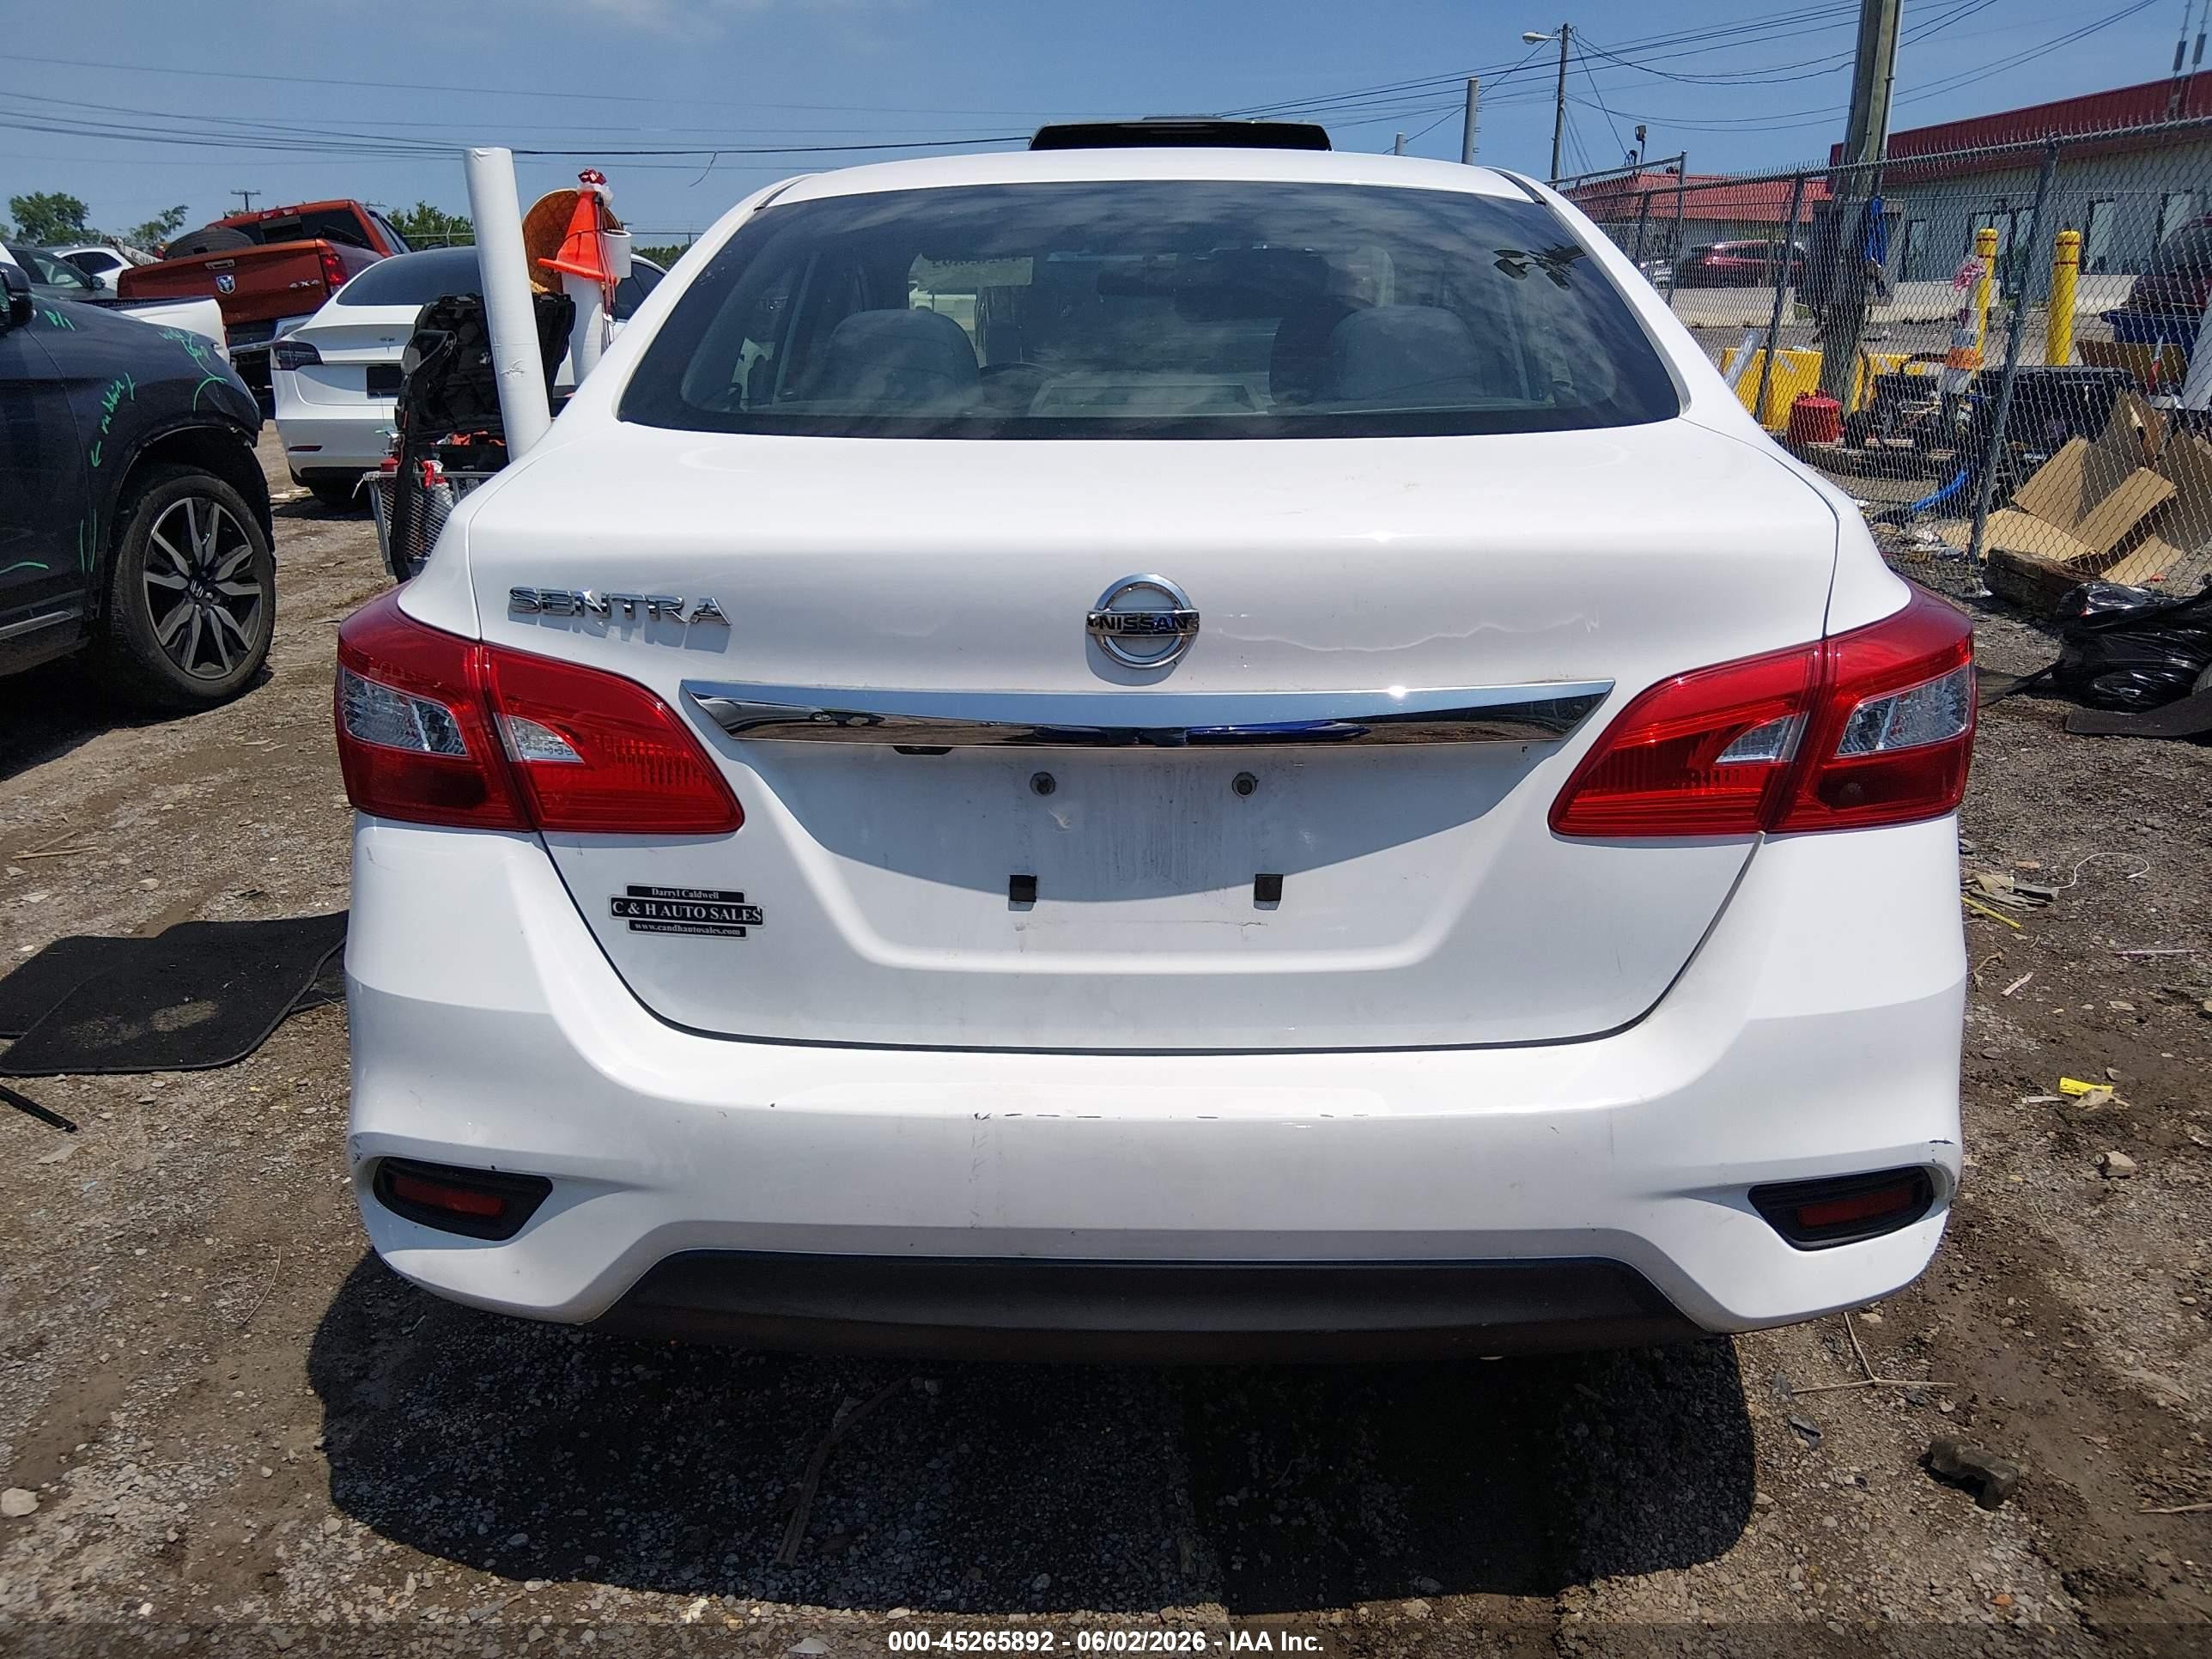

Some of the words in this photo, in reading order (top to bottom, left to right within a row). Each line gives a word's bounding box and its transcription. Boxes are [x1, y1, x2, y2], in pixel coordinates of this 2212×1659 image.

[510, 587, 732, 625] SENTRA
[1099, 617, 1188, 630] NISSAN
[652, 888, 681, 899] Darryl
[682, 890, 720, 899] Caldwell
[612, 902, 624, 914] C
[628, 902, 641, 915] &
[646, 903, 658, 916] H
[660, 905, 707, 920] AUTO
[710, 907, 763, 922] SALES
[634, 923, 741, 936] www.candhautosales.com
